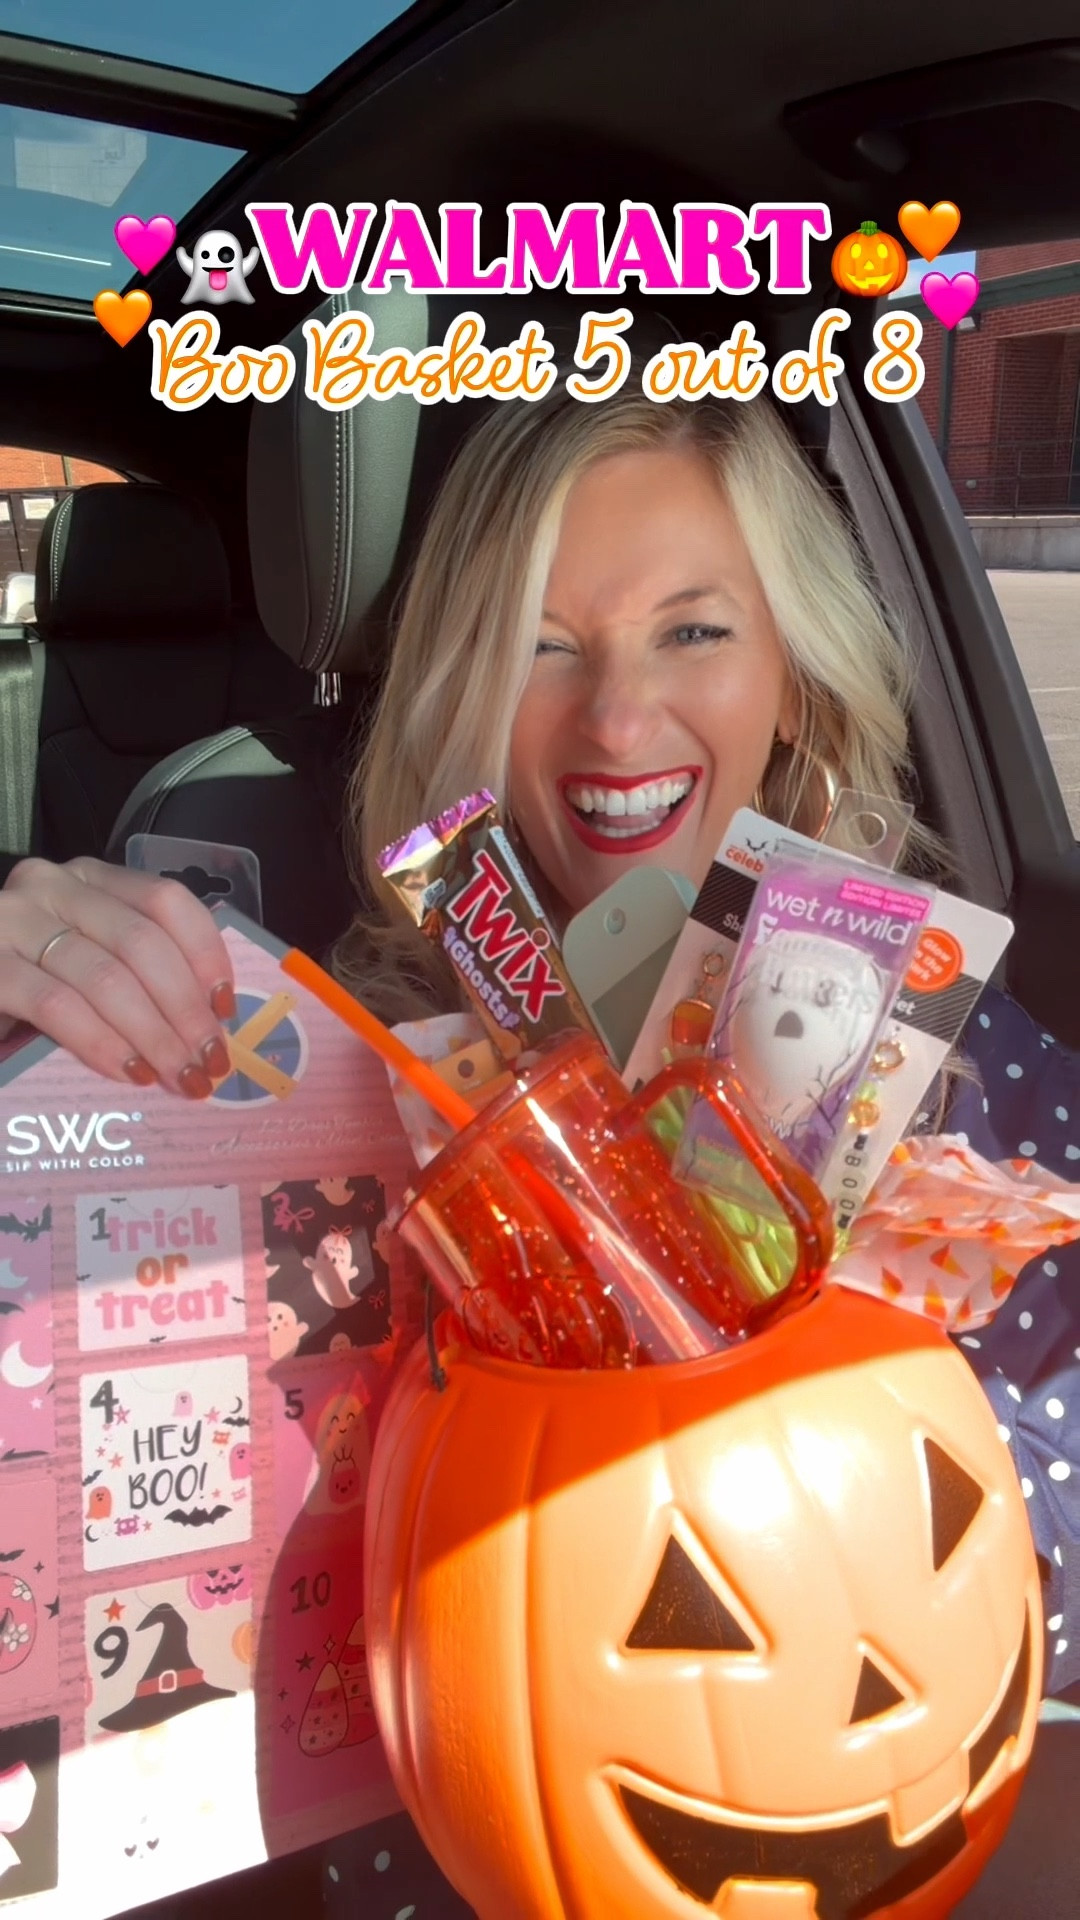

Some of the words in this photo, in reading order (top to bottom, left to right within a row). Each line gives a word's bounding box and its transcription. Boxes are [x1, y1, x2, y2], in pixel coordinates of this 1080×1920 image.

[766, 887, 820, 921] wet
[821, 906, 844, 927] n
[847, 911, 914, 947] wild
[5, 1160, 32, 1174] SIP
[40, 1158, 81, 1171] WITH
[89, 1154, 145, 1169] COLOR
[89, 1208, 111, 1241] 1
[107, 1208, 218, 1252] trick
[136, 1253, 189, 1288] or
[95, 1280, 230, 1330] treat
[89, 1379, 120, 1425] 4
[284, 1388, 305, 1420] 5
[133, 1420, 202, 1465] HEY
[129, 1462, 208, 1509] BOO!
[291, 1571, 332, 1614] 10
[94, 1626, 129, 1679] 9
